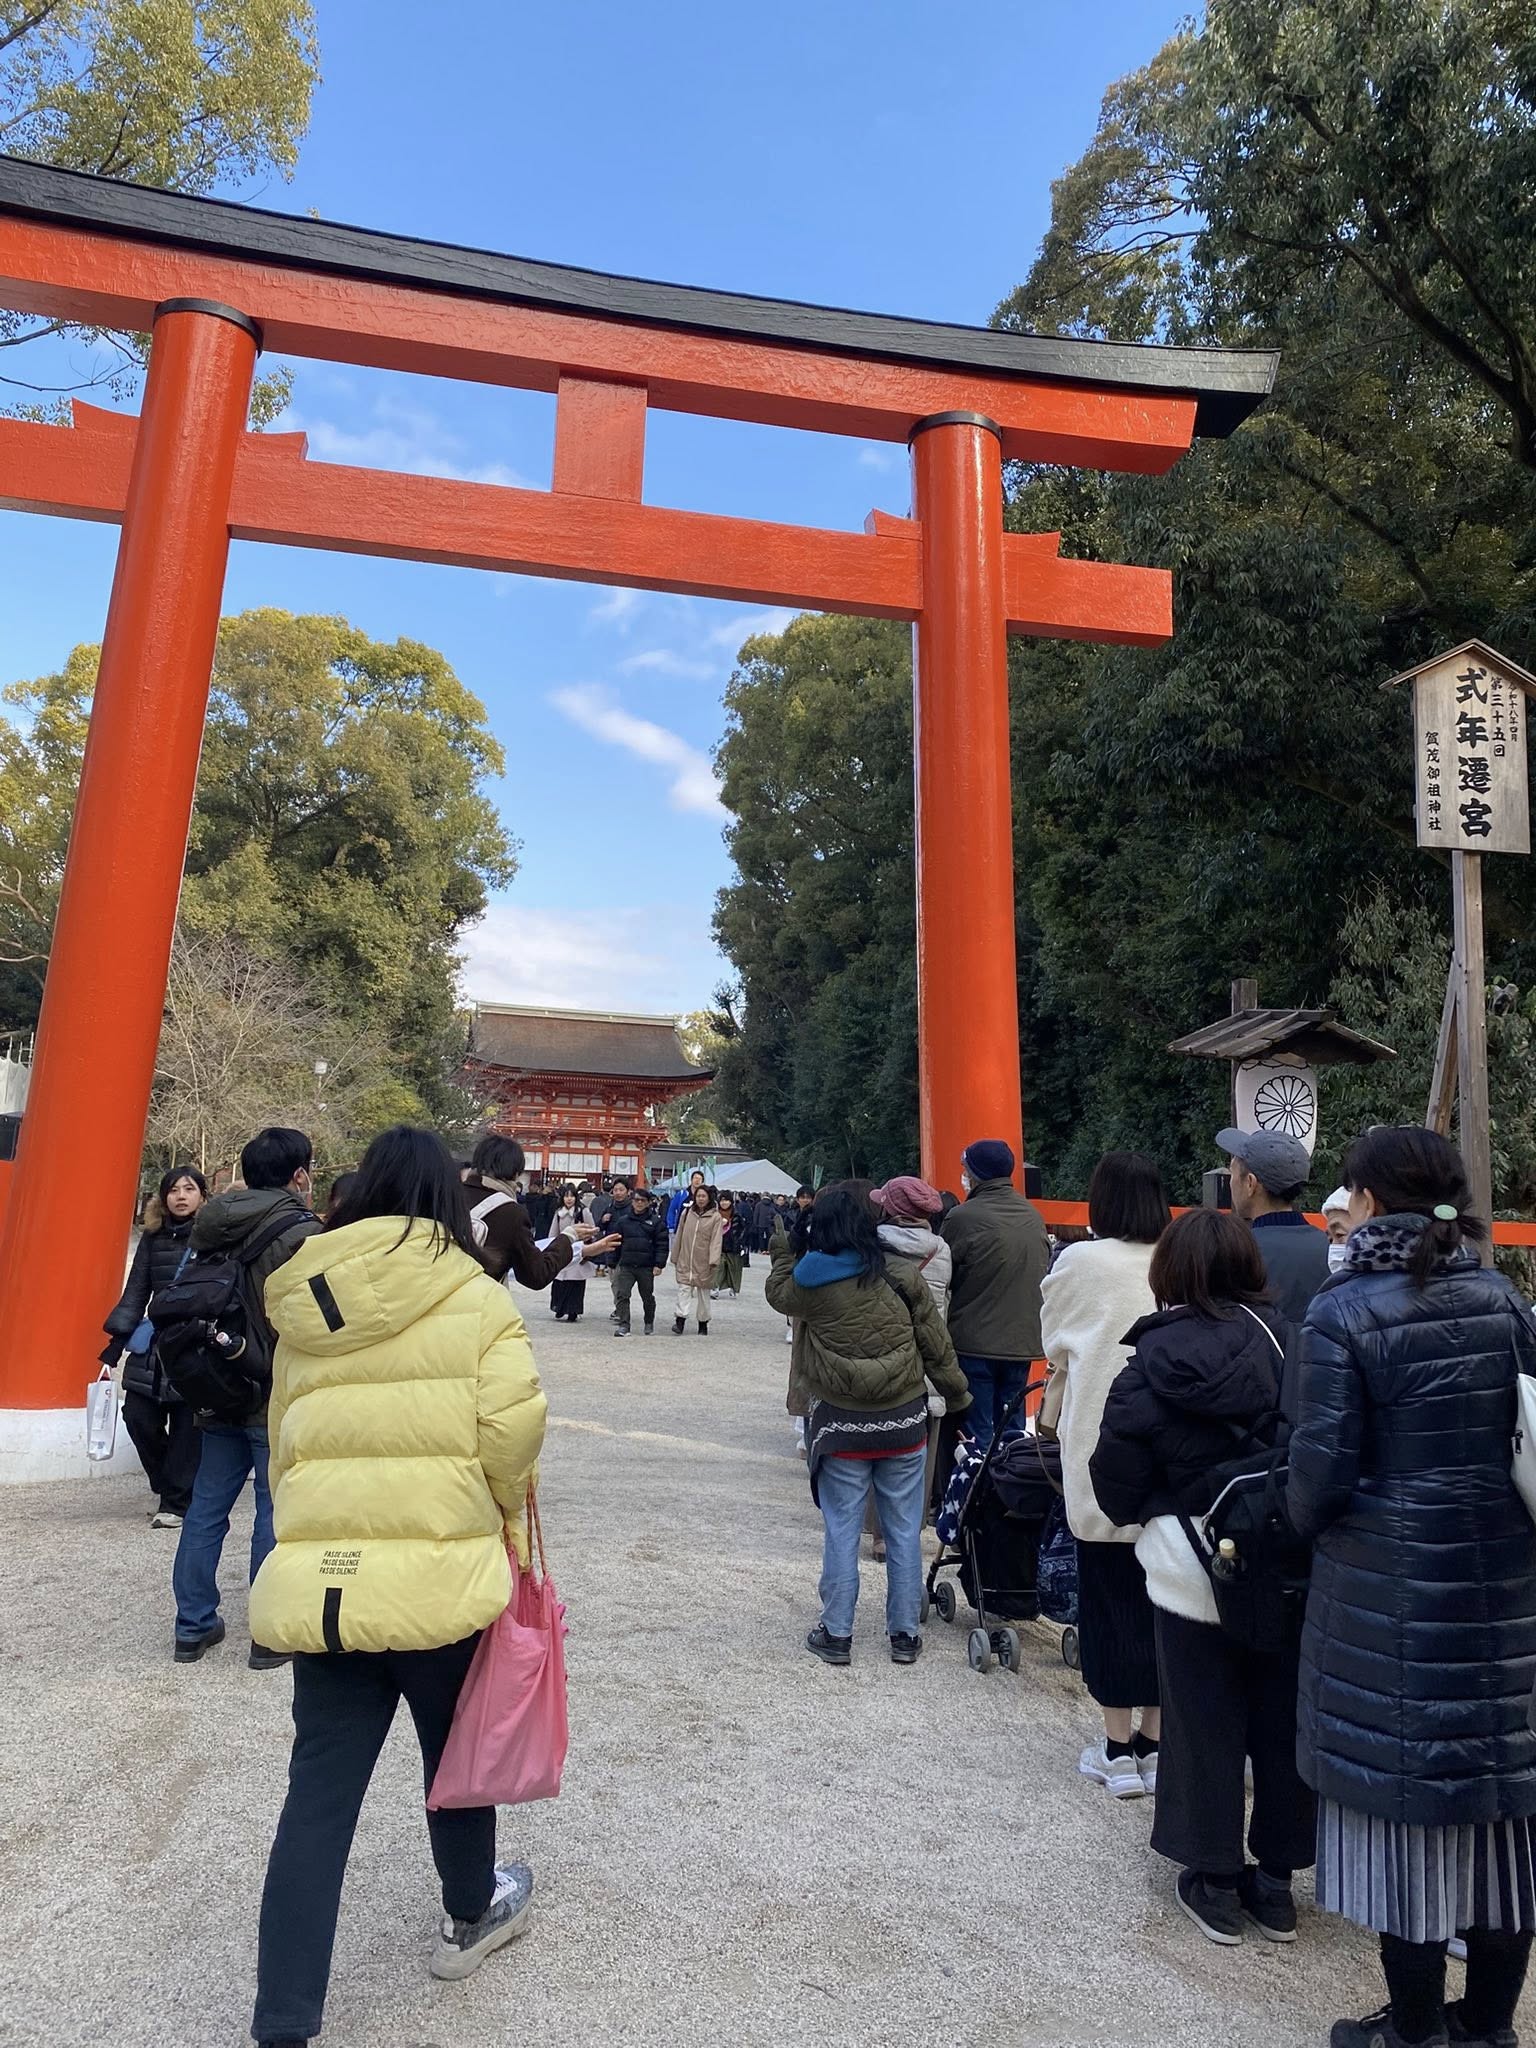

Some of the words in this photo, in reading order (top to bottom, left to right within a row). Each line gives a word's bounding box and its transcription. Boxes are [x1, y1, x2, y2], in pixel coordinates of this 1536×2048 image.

[1455, 667, 1493, 838] 式年遷宮
[1490, 676, 1506, 757] 第三十五回
[1425, 731, 1442, 831] 賀茂御祖神社
